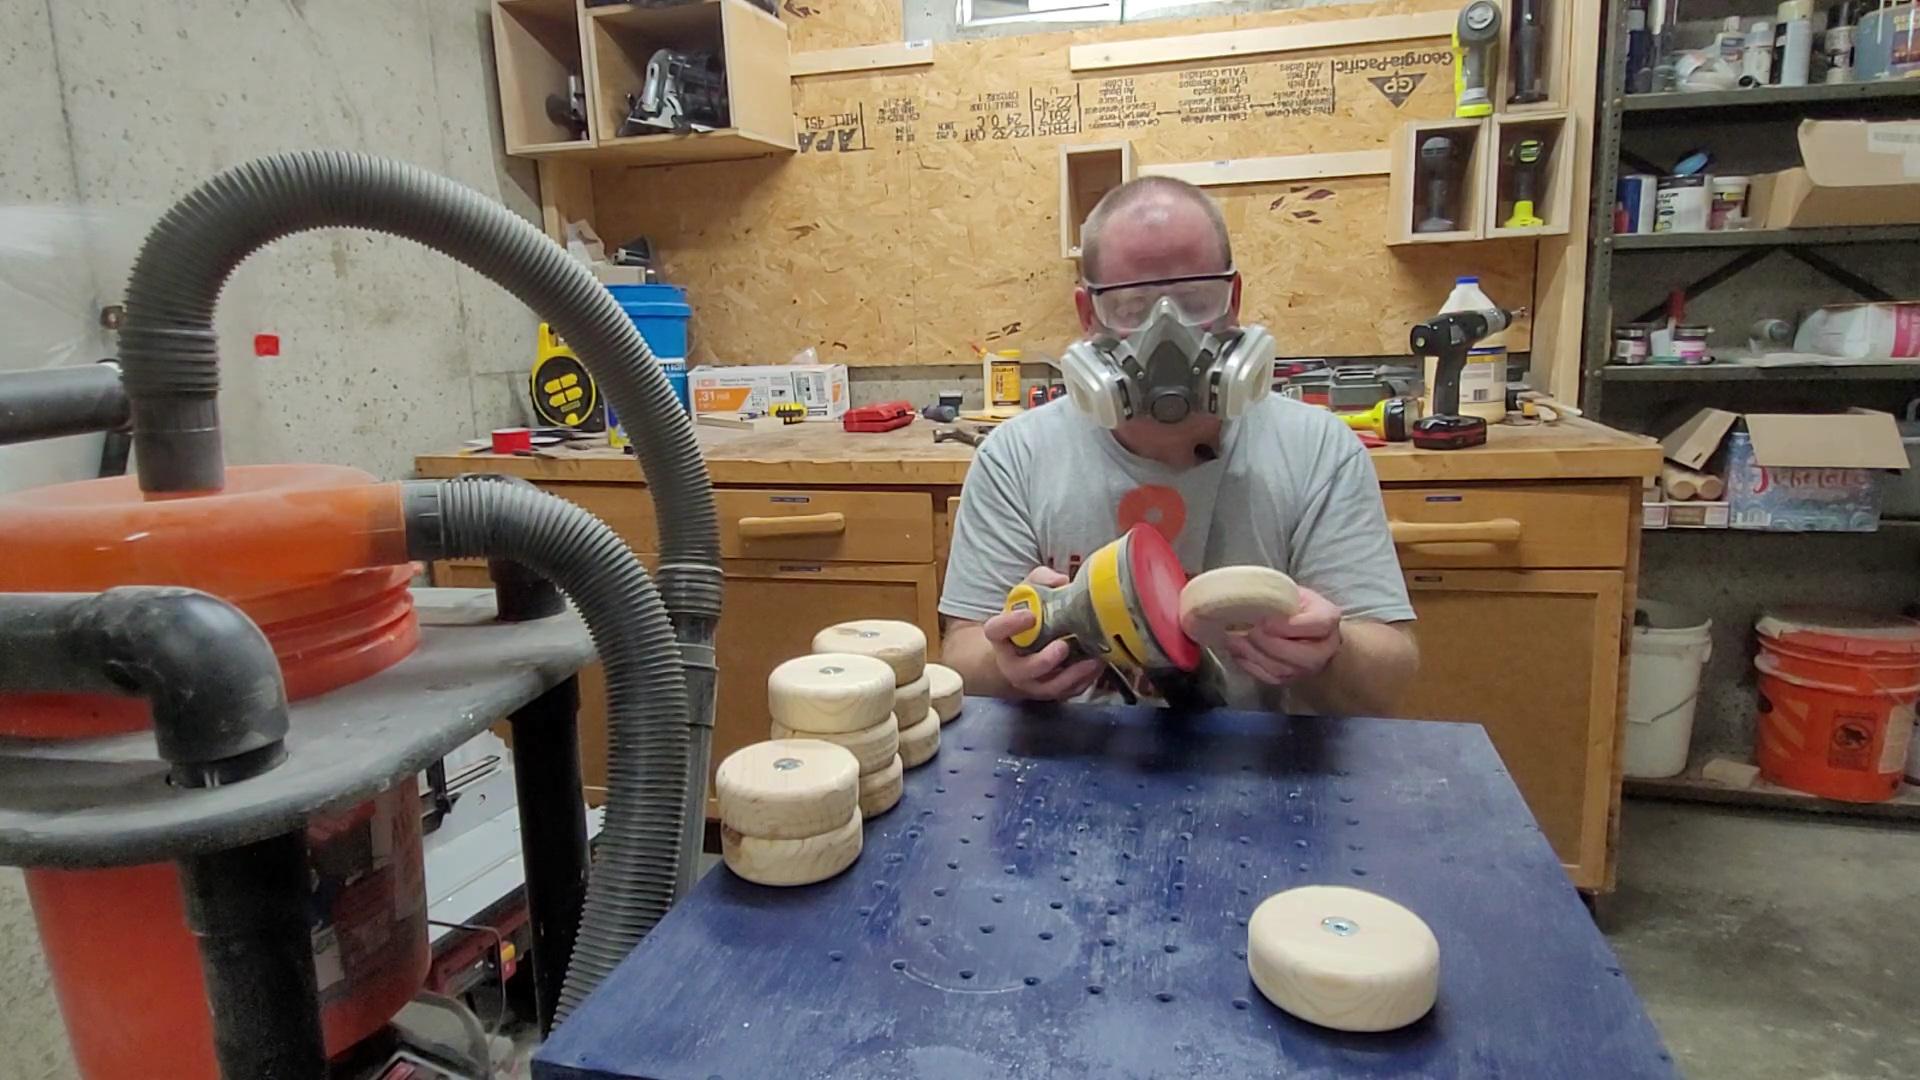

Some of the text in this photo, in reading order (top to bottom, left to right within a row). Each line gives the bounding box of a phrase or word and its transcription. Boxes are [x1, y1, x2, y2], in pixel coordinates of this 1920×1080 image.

[1335, 51, 1454, 75] Georgia-Pacific
[1384, 77, 1414, 94] GP
[1034, 96, 1072, 111] 22:45
[804, 115, 824, 130] 451
[1007, 113, 1022, 126] 24
[1039, 110, 1071, 126] 2017
[962, 128, 986, 142] CAT
[991, 124, 1030, 140] 23/32
[798, 128, 857, 154] APA
